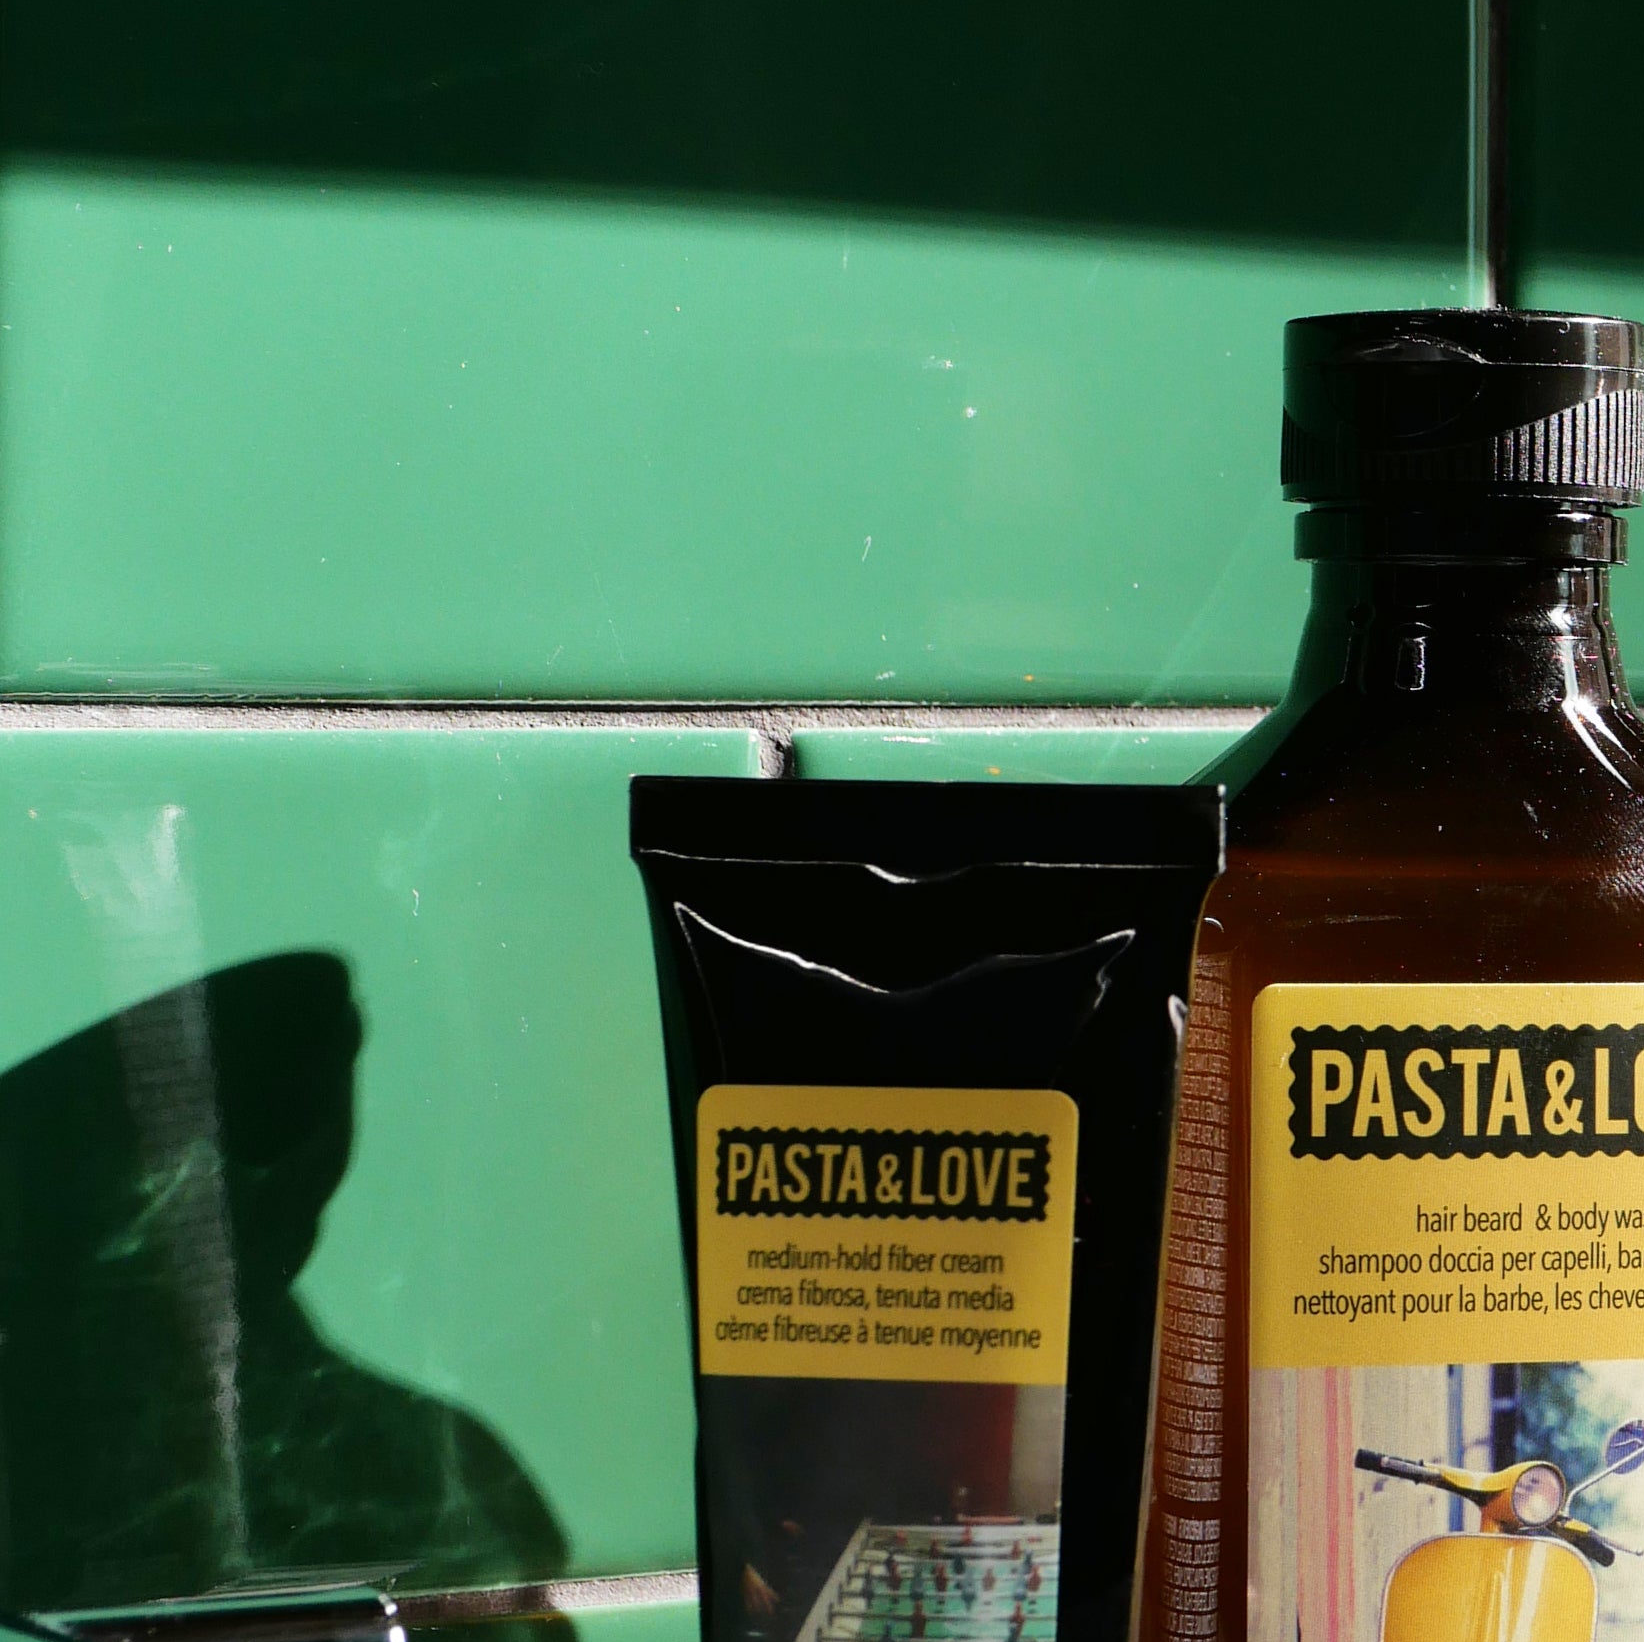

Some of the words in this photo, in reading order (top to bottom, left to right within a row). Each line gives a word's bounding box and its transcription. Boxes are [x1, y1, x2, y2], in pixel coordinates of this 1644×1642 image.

[1416, 1204, 1458, 1233] hair
[1463, 1203, 1522, 1232] beard
[1535, 1204, 1551, 1231] &
[1558, 1202, 1609, 1237] body
[748, 1243, 881, 1271] medium-hold
[887, 1247, 935, 1273] fiber
[941, 1251, 1004, 1274] cream
[1319, 1246, 1422, 1281] shampoo
[1428, 1244, 1494, 1273] doccia
[1501, 1249, 1536, 1285] per
[1541, 1243, 1612, 1279] capelli,
[737, 1281, 793, 1306] crema
[798, 1279, 870, 1311] fibrosa,
[876, 1283, 941, 1310] tenuta
[947, 1285, 1015, 1312] media
[1294, 1288, 1396, 1321] nettoyant
[1402, 1290, 1453, 1321] pour
[1459, 1286, 1476, 1313] la
[1483, 1285, 1548, 1315] barbe,
[1554, 1285, 1582, 1312] les
[715, 1317, 769, 1342] crème
[773, 1316, 852, 1346] fibreuse
[857, 1318, 868, 1344] à
[875, 1321, 935, 1347] tenue
[940, 1323, 1042, 1355] moyenne
